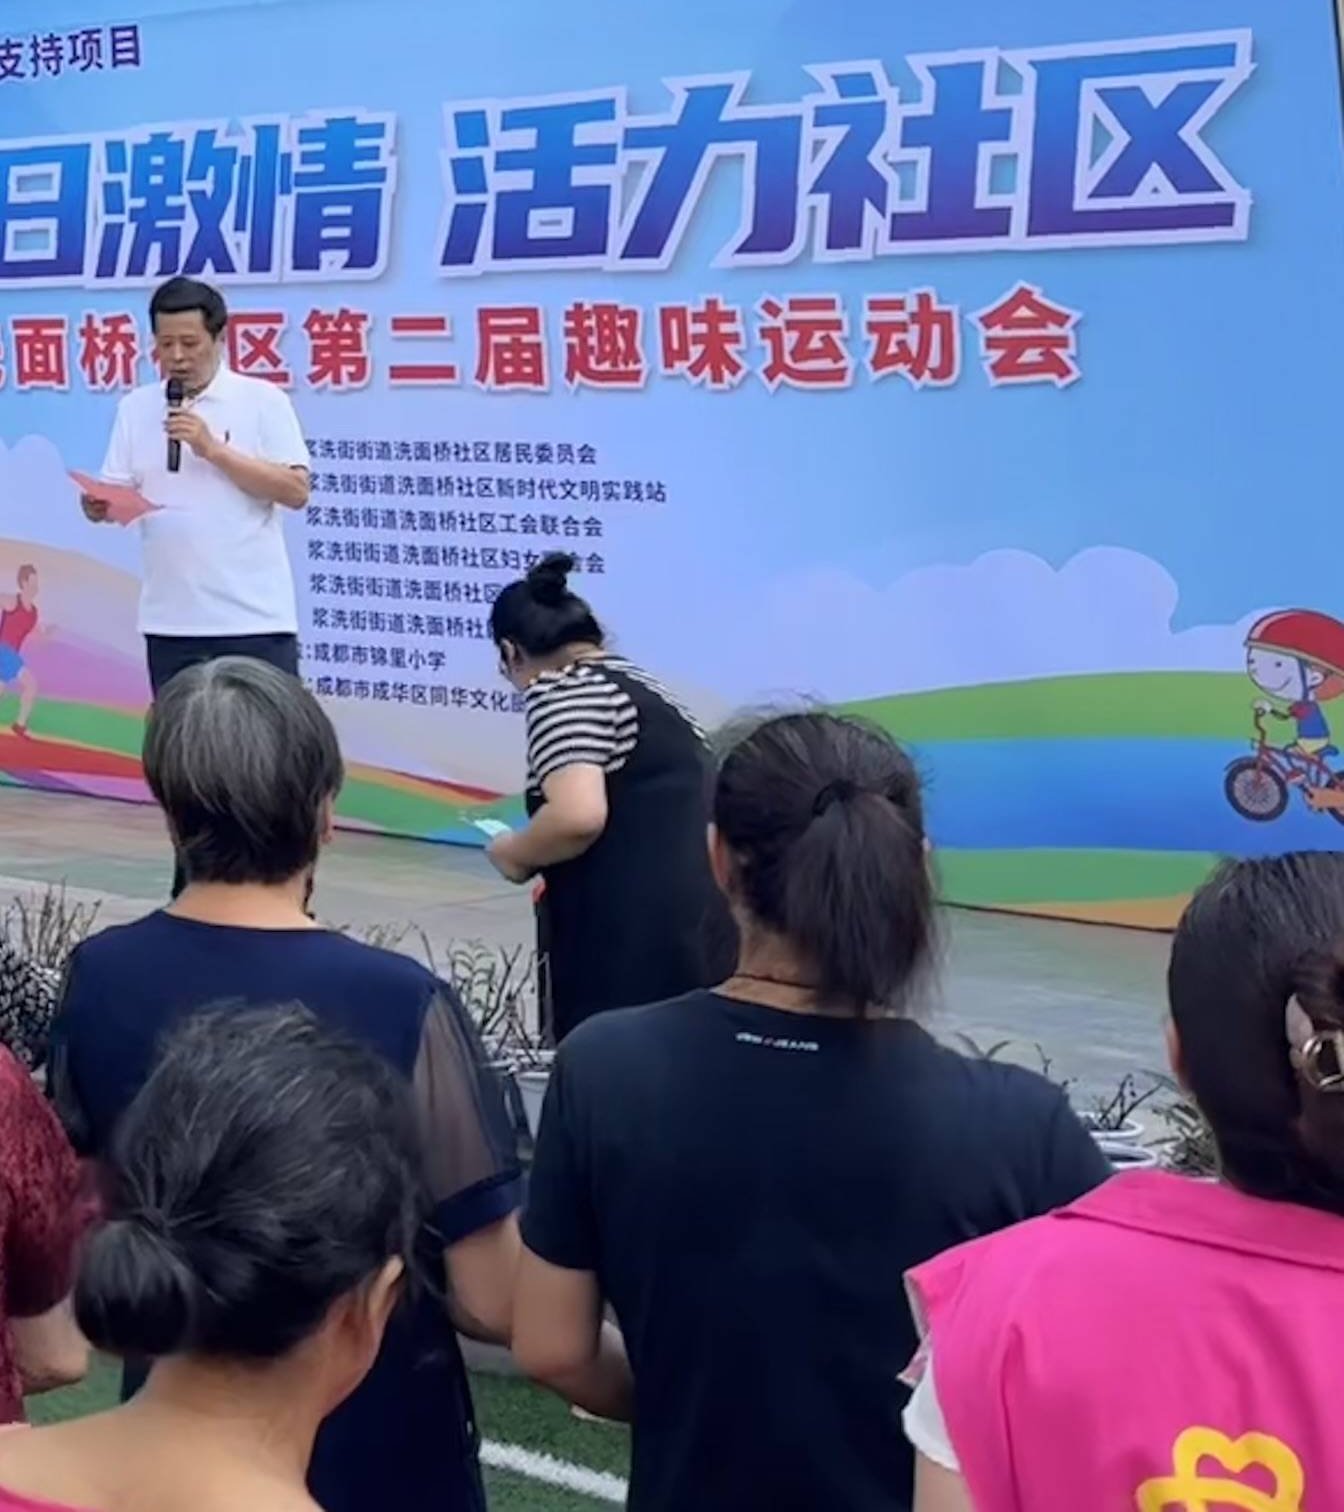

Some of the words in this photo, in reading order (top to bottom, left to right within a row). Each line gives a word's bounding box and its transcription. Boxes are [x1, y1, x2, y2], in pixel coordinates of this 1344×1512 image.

[438, 29, 1255, 276] 活力社区
[306, 506, 603, 537] 浆洗街街道洗面桥社区工会联合会
[308, 539, 605, 574] 浆洗街街道洗面桥社区妇女合会
[312, 608, 494, 639] 浆洗街街道洗面桥社
